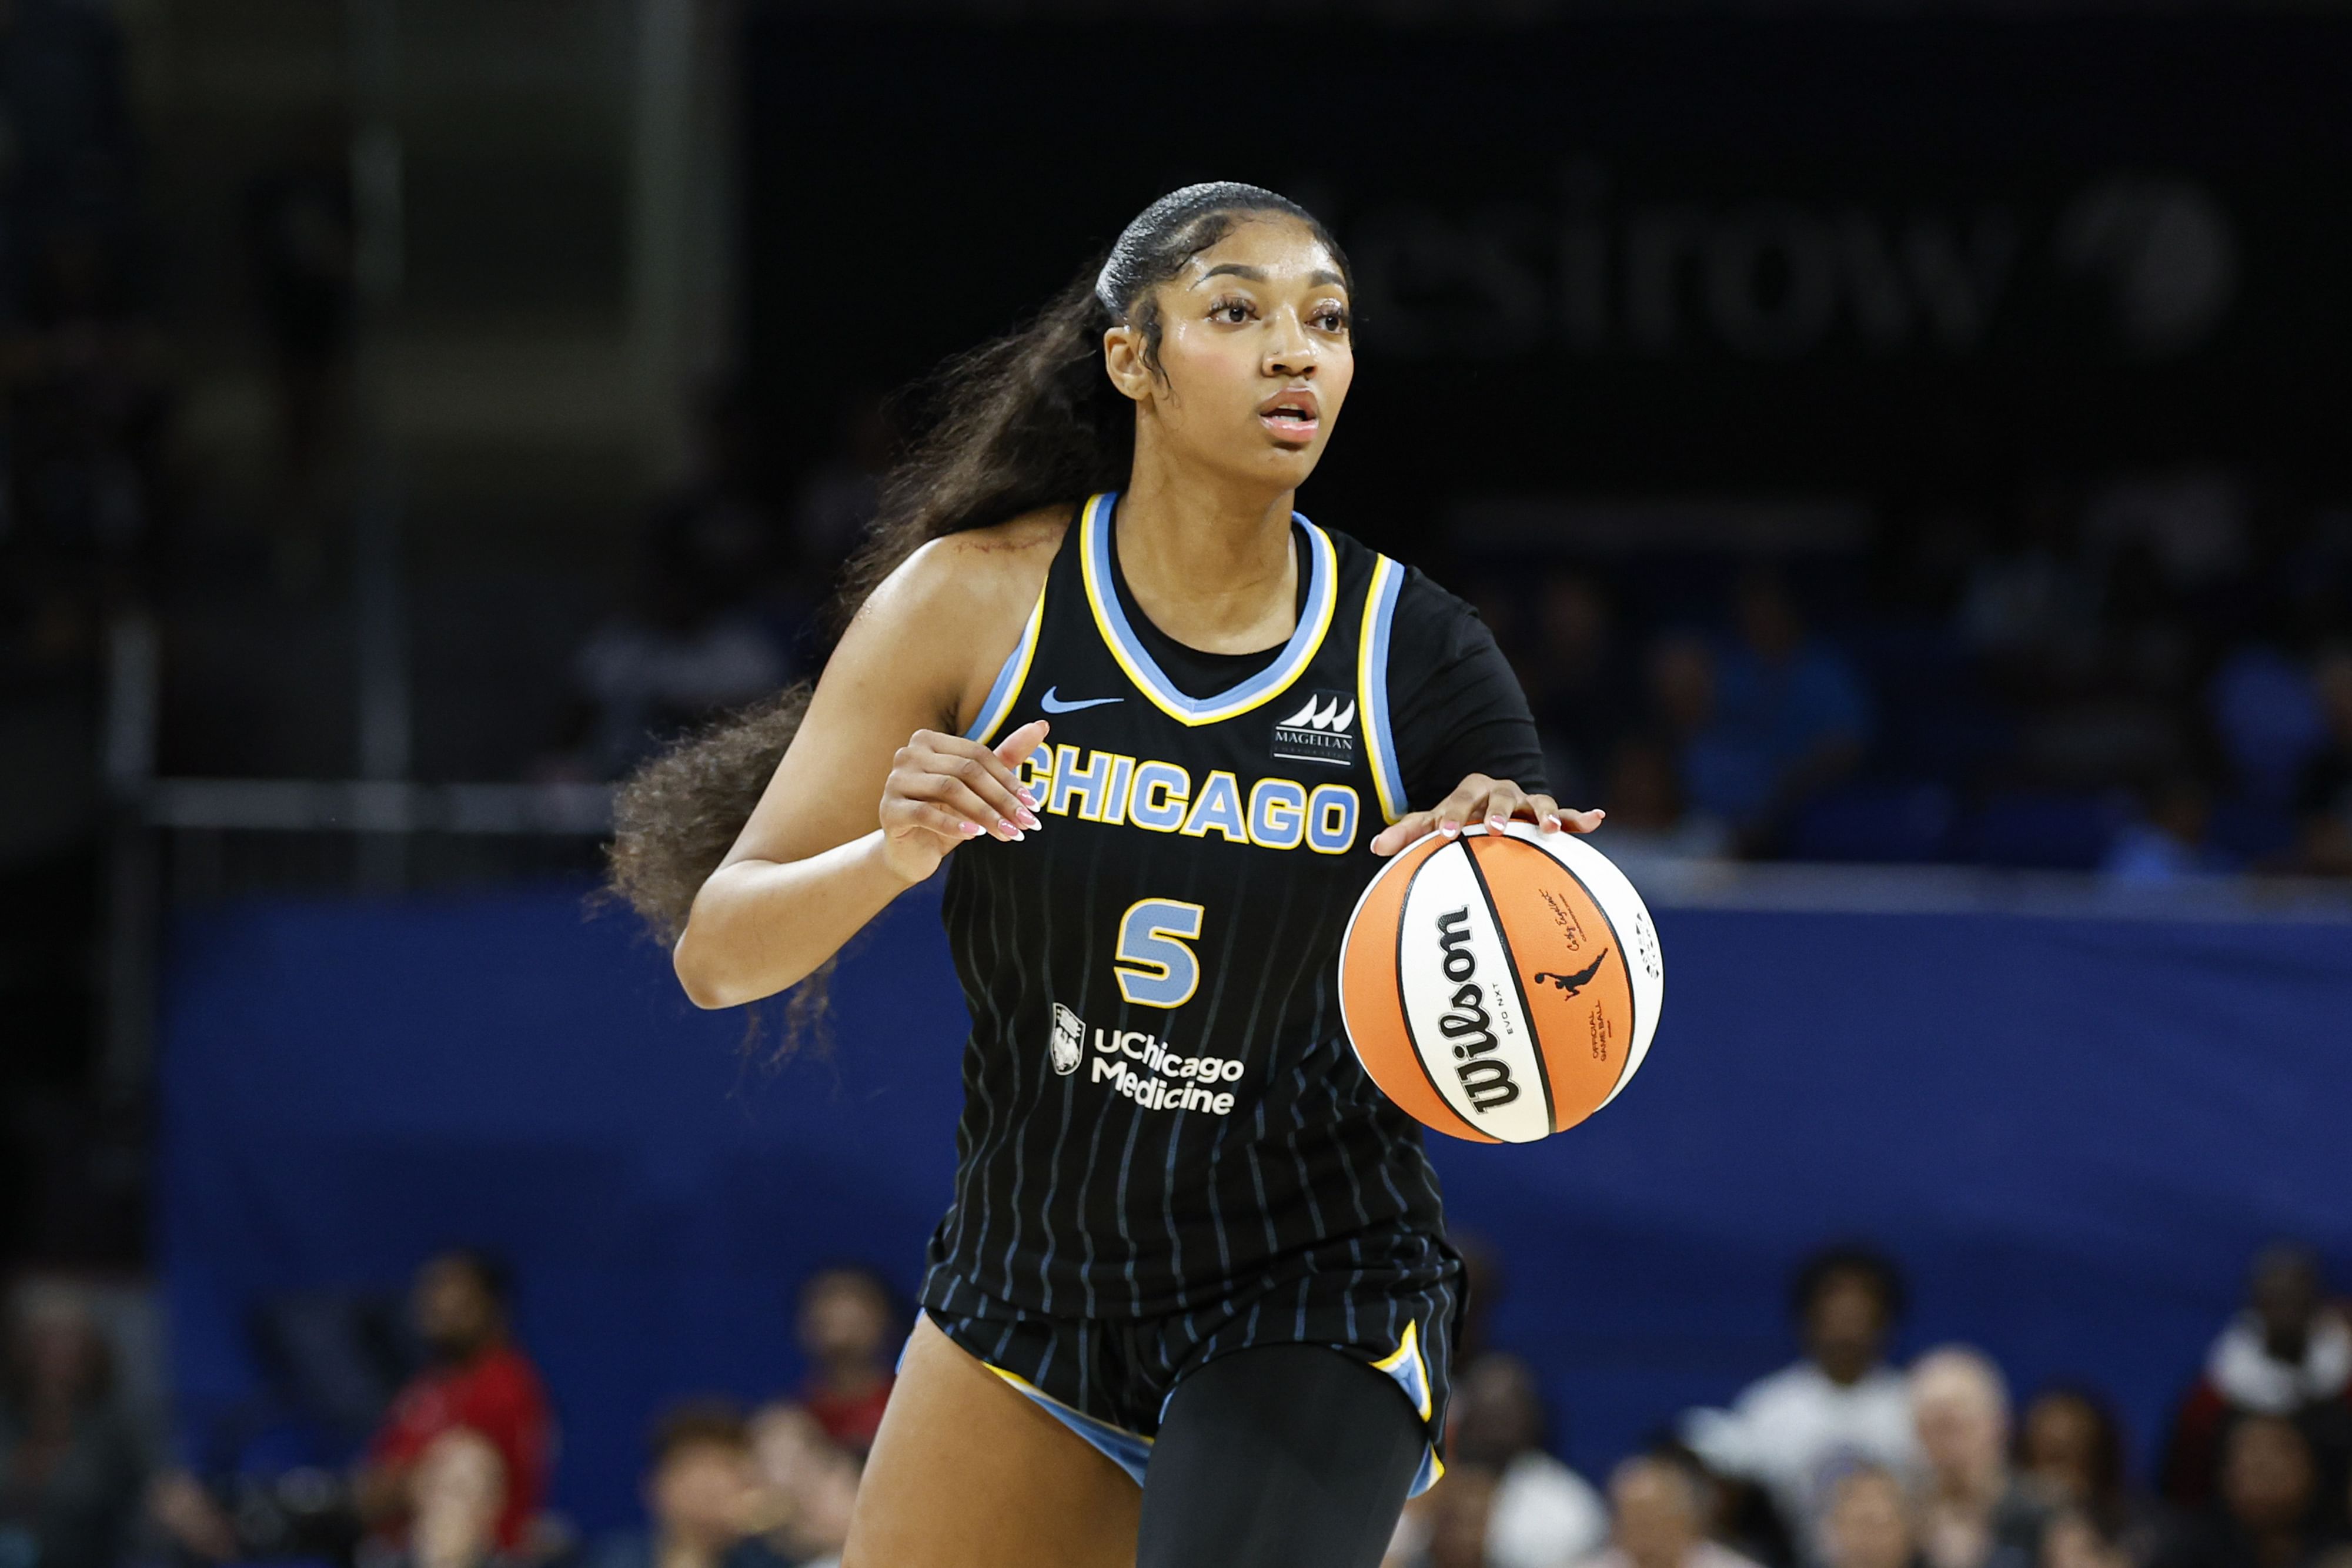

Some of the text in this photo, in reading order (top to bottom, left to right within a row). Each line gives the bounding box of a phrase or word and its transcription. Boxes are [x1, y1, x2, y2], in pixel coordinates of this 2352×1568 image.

[1297, 156, 2020, 356] esirow
[1275, 731, 1352, 750] MAGELLAN
[1114, 897, 1205, 1009] 5
[1435, 904, 1521, 1115] Wilson
[1492, 982, 1514, 1035] EVO NXT
[1588, 1011, 1599, 1059] OFFICIAL
[1595, 999, 1604, 1029] BALL
[1094, 1028, 1244, 1084] UChicago
[1091, 1057, 1235, 1115] Medicine
